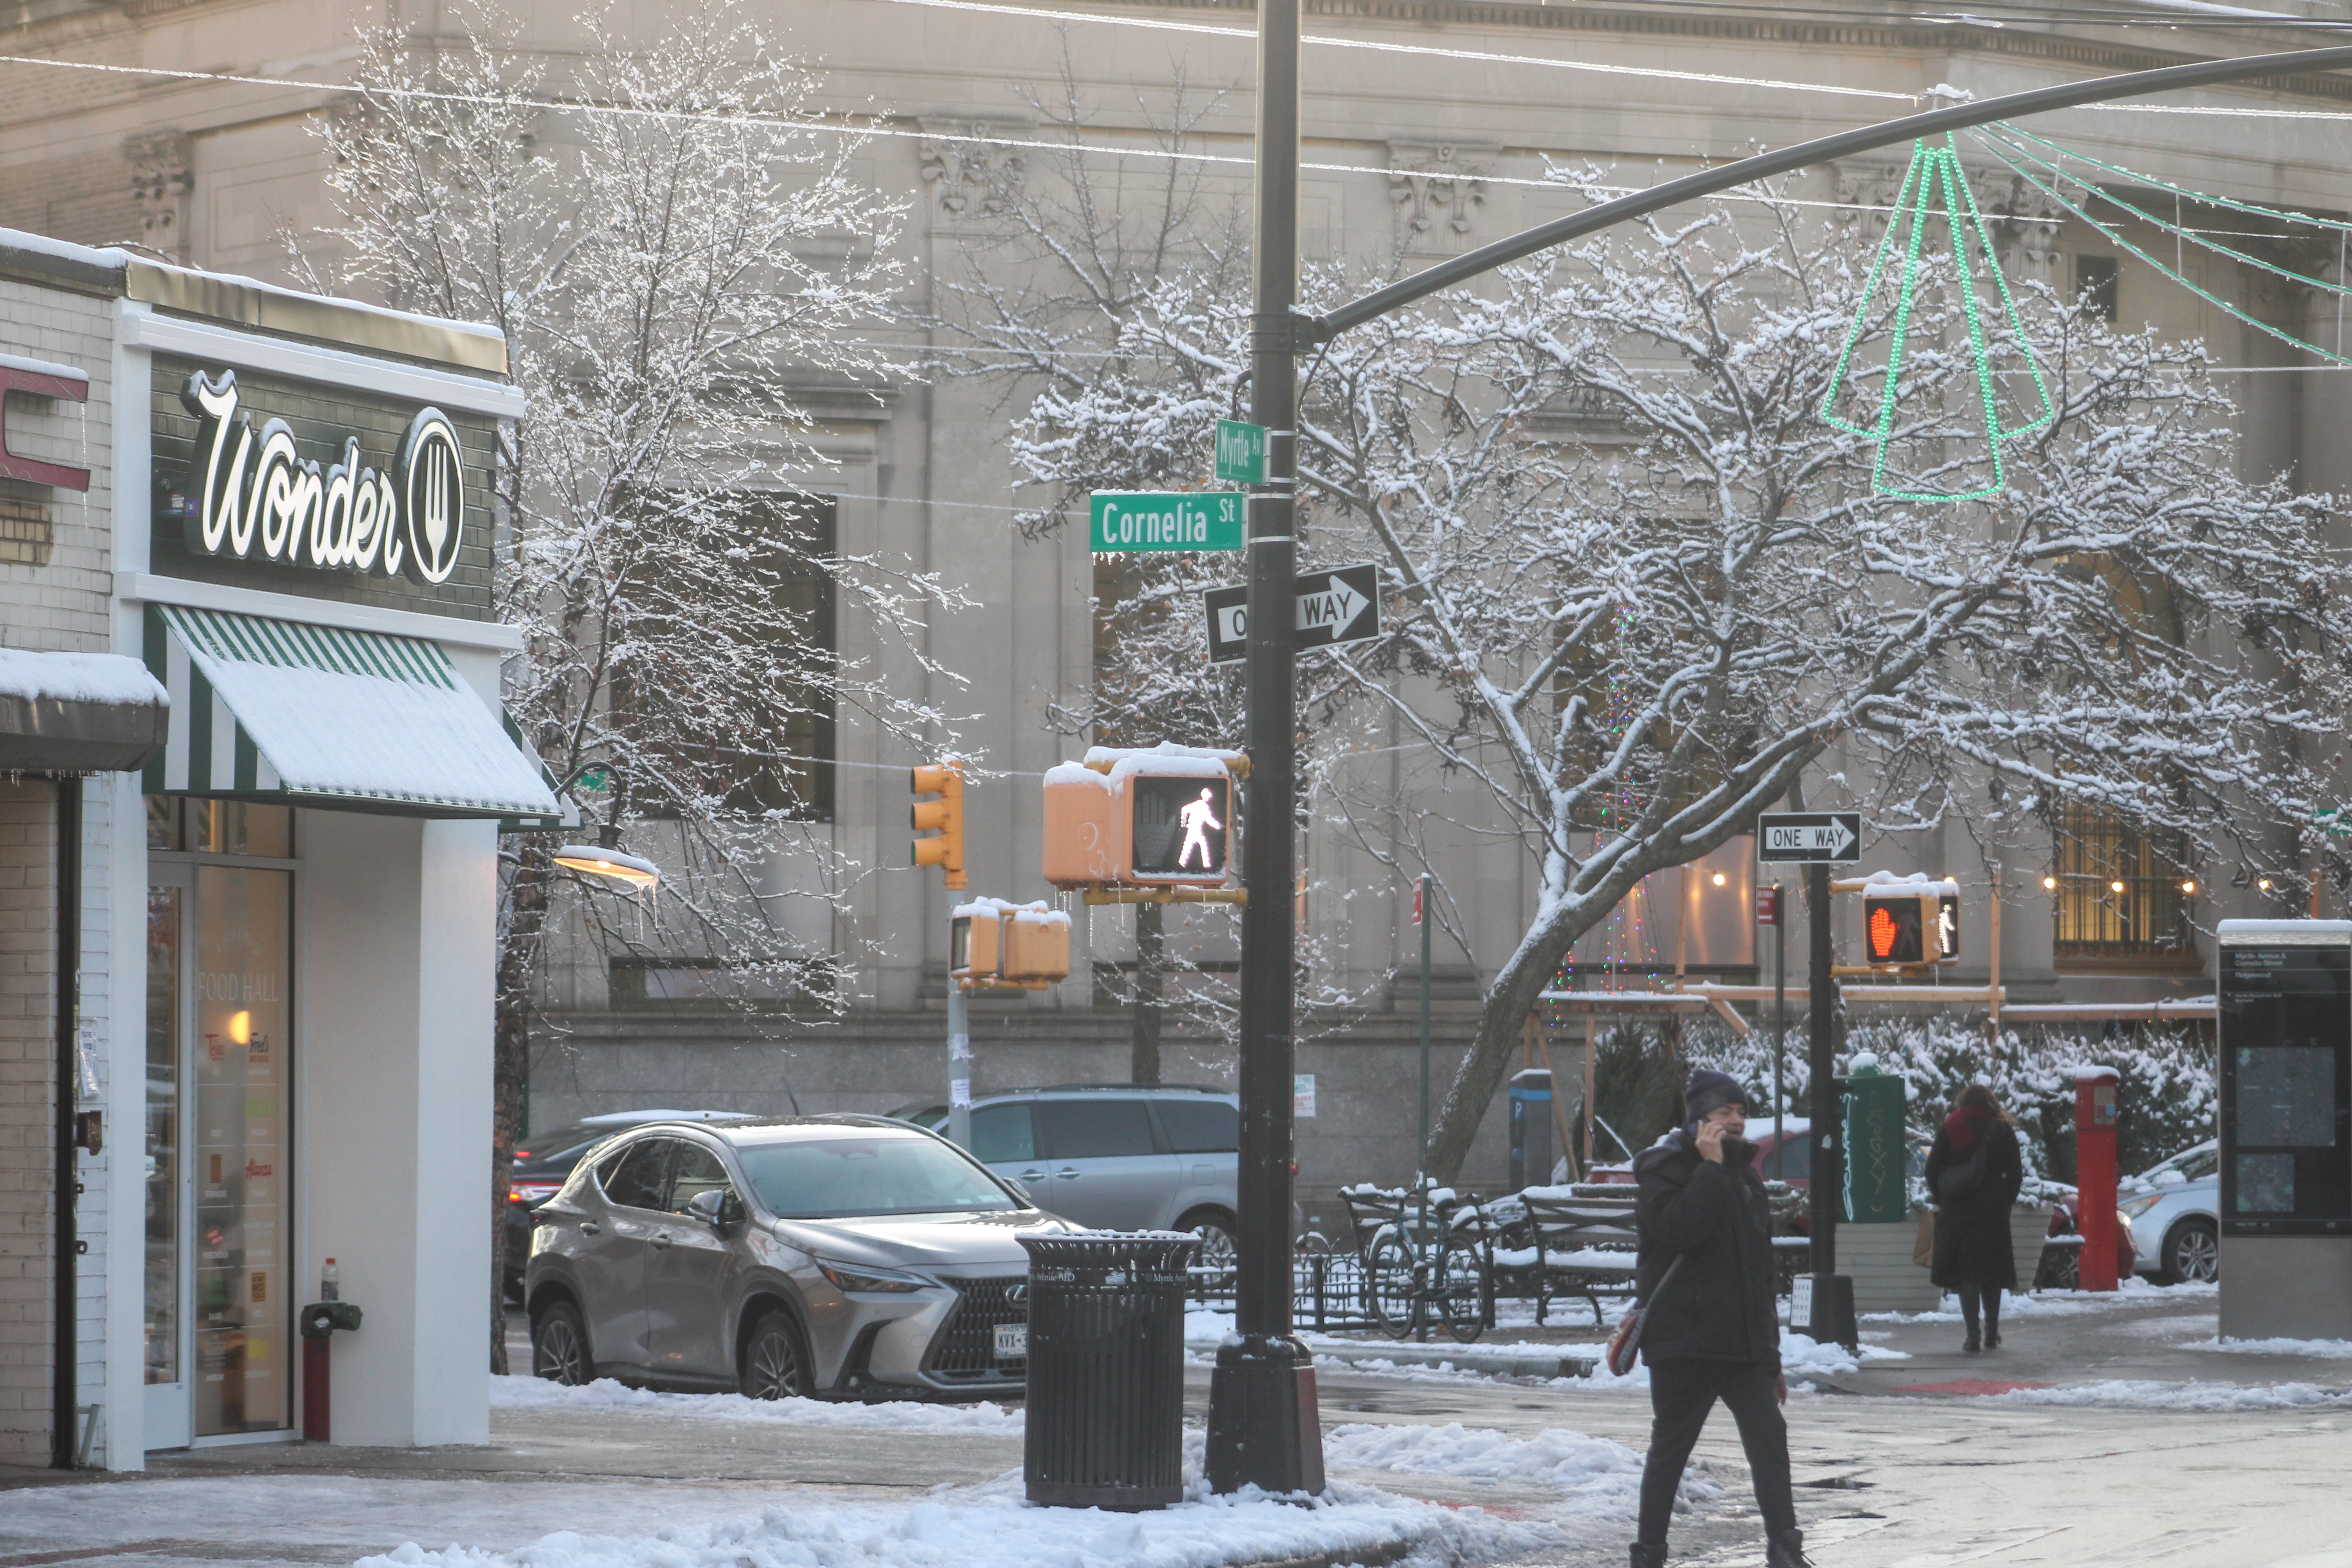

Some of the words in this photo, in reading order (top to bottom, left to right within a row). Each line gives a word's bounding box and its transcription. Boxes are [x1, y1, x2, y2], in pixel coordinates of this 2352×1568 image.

[1220, 426, 1249, 474] Myrtle
[1252, 432, 1260, 456] Av
[198, 383, 404, 575] Wonder
[1103, 503, 1207, 544] Cornelia
[1219, 498, 1234, 522] St
[1303, 591, 1352, 625] WAY
[1774, 829, 1801, 847] ONE
[1815, 829, 1844, 846] WAY
[199, 973, 238, 1000] FOOD
[243, 973, 278, 1001] HALL
[1515, 1102, 1522, 1118] P
[245, 1158, 272, 1180] Alanza
[1037, 1273, 1057, 1281] Avenue
[1059, 1273, 1075, 1281] BID
[1153, 1273, 1174, 1283] Myrtle
